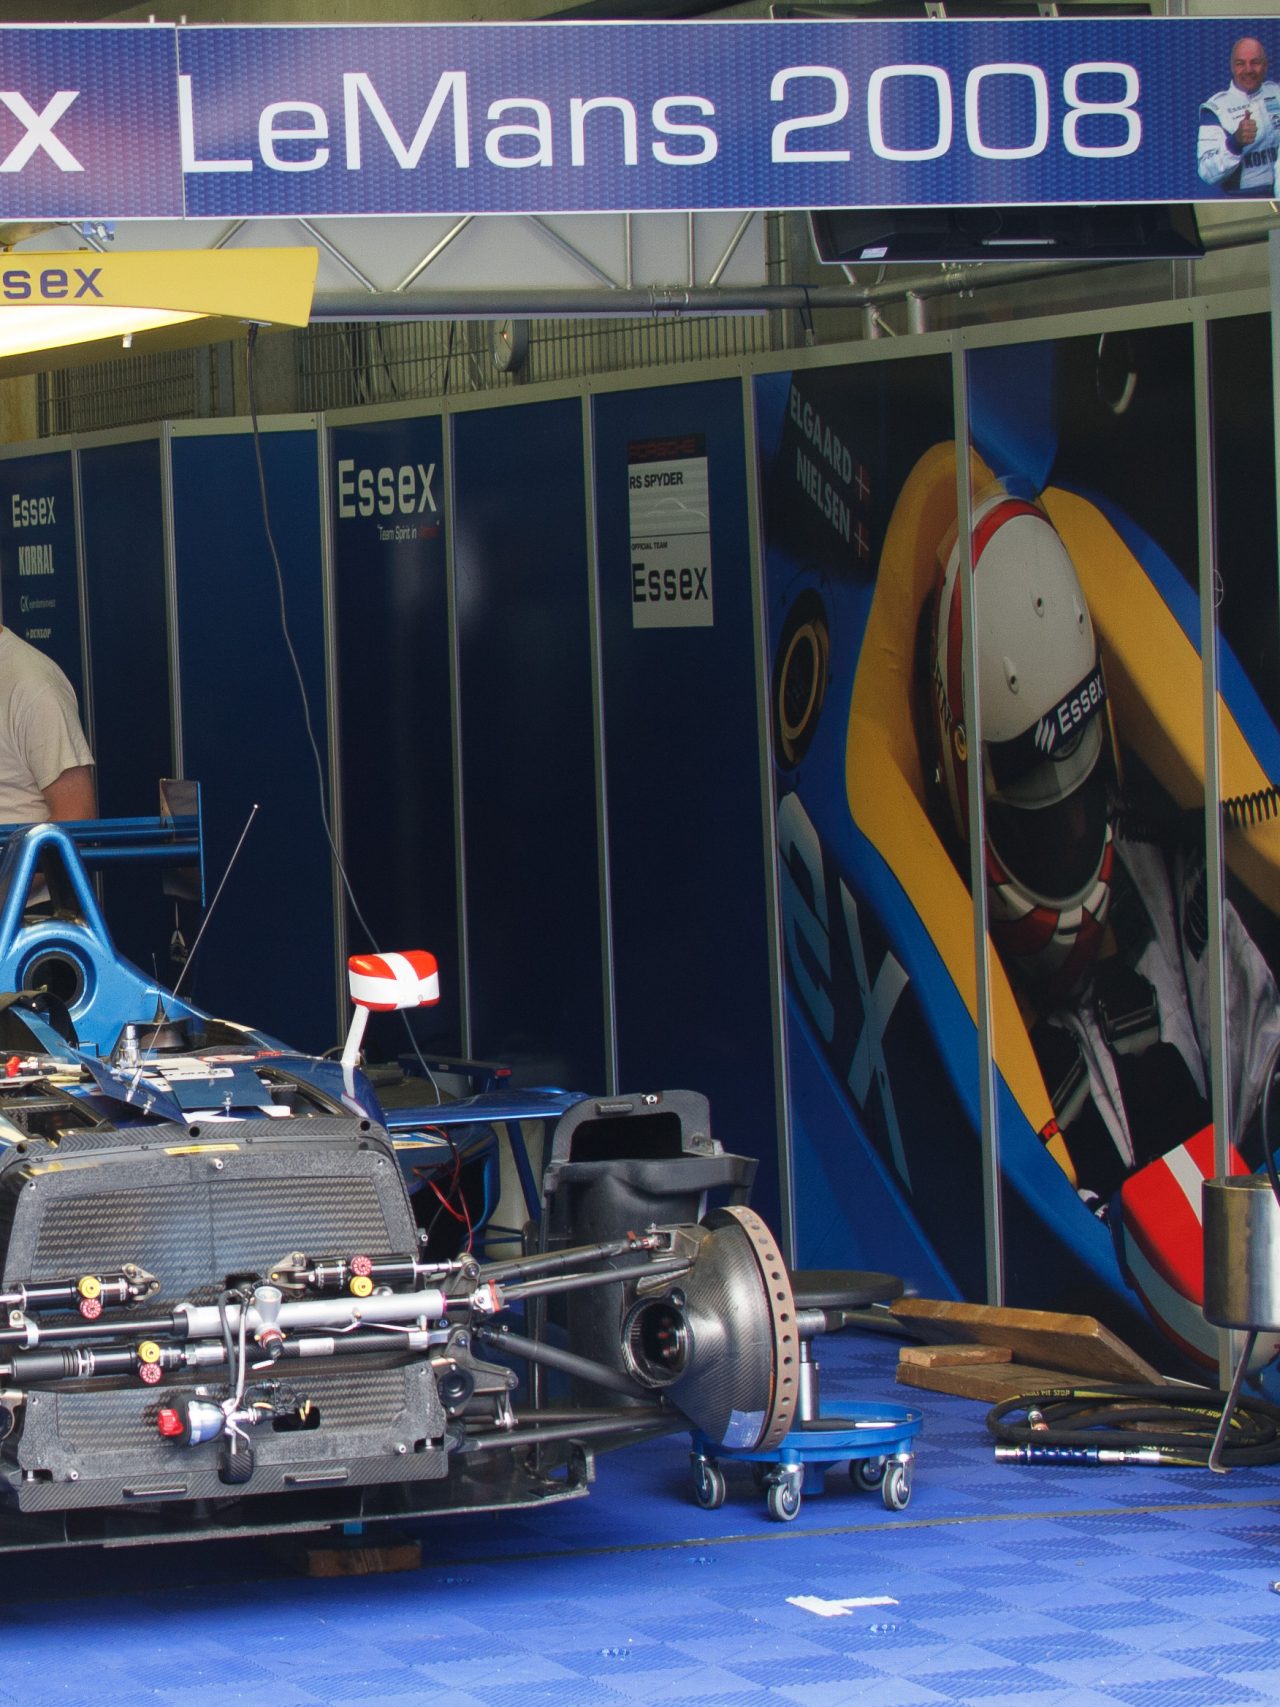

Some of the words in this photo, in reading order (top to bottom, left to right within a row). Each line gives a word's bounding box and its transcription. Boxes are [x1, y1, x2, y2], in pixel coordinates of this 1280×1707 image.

[770, 61, 1143, 164] 2008
[790, 383, 852, 486] ELGAARD
[338, 459, 438, 519] Essex
[629, 474, 643, 490] RS
[644, 471, 685, 489] SPYDER
[796, 447, 850, 544] NIELSEN
[11, 494, 57, 529] Essex
[18, 543, 55, 577] KORRAL
[653, 541, 669, 550] TEAM
[631, 562, 710, 603] Essex
[1056, 674, 1105, 736] Essex
